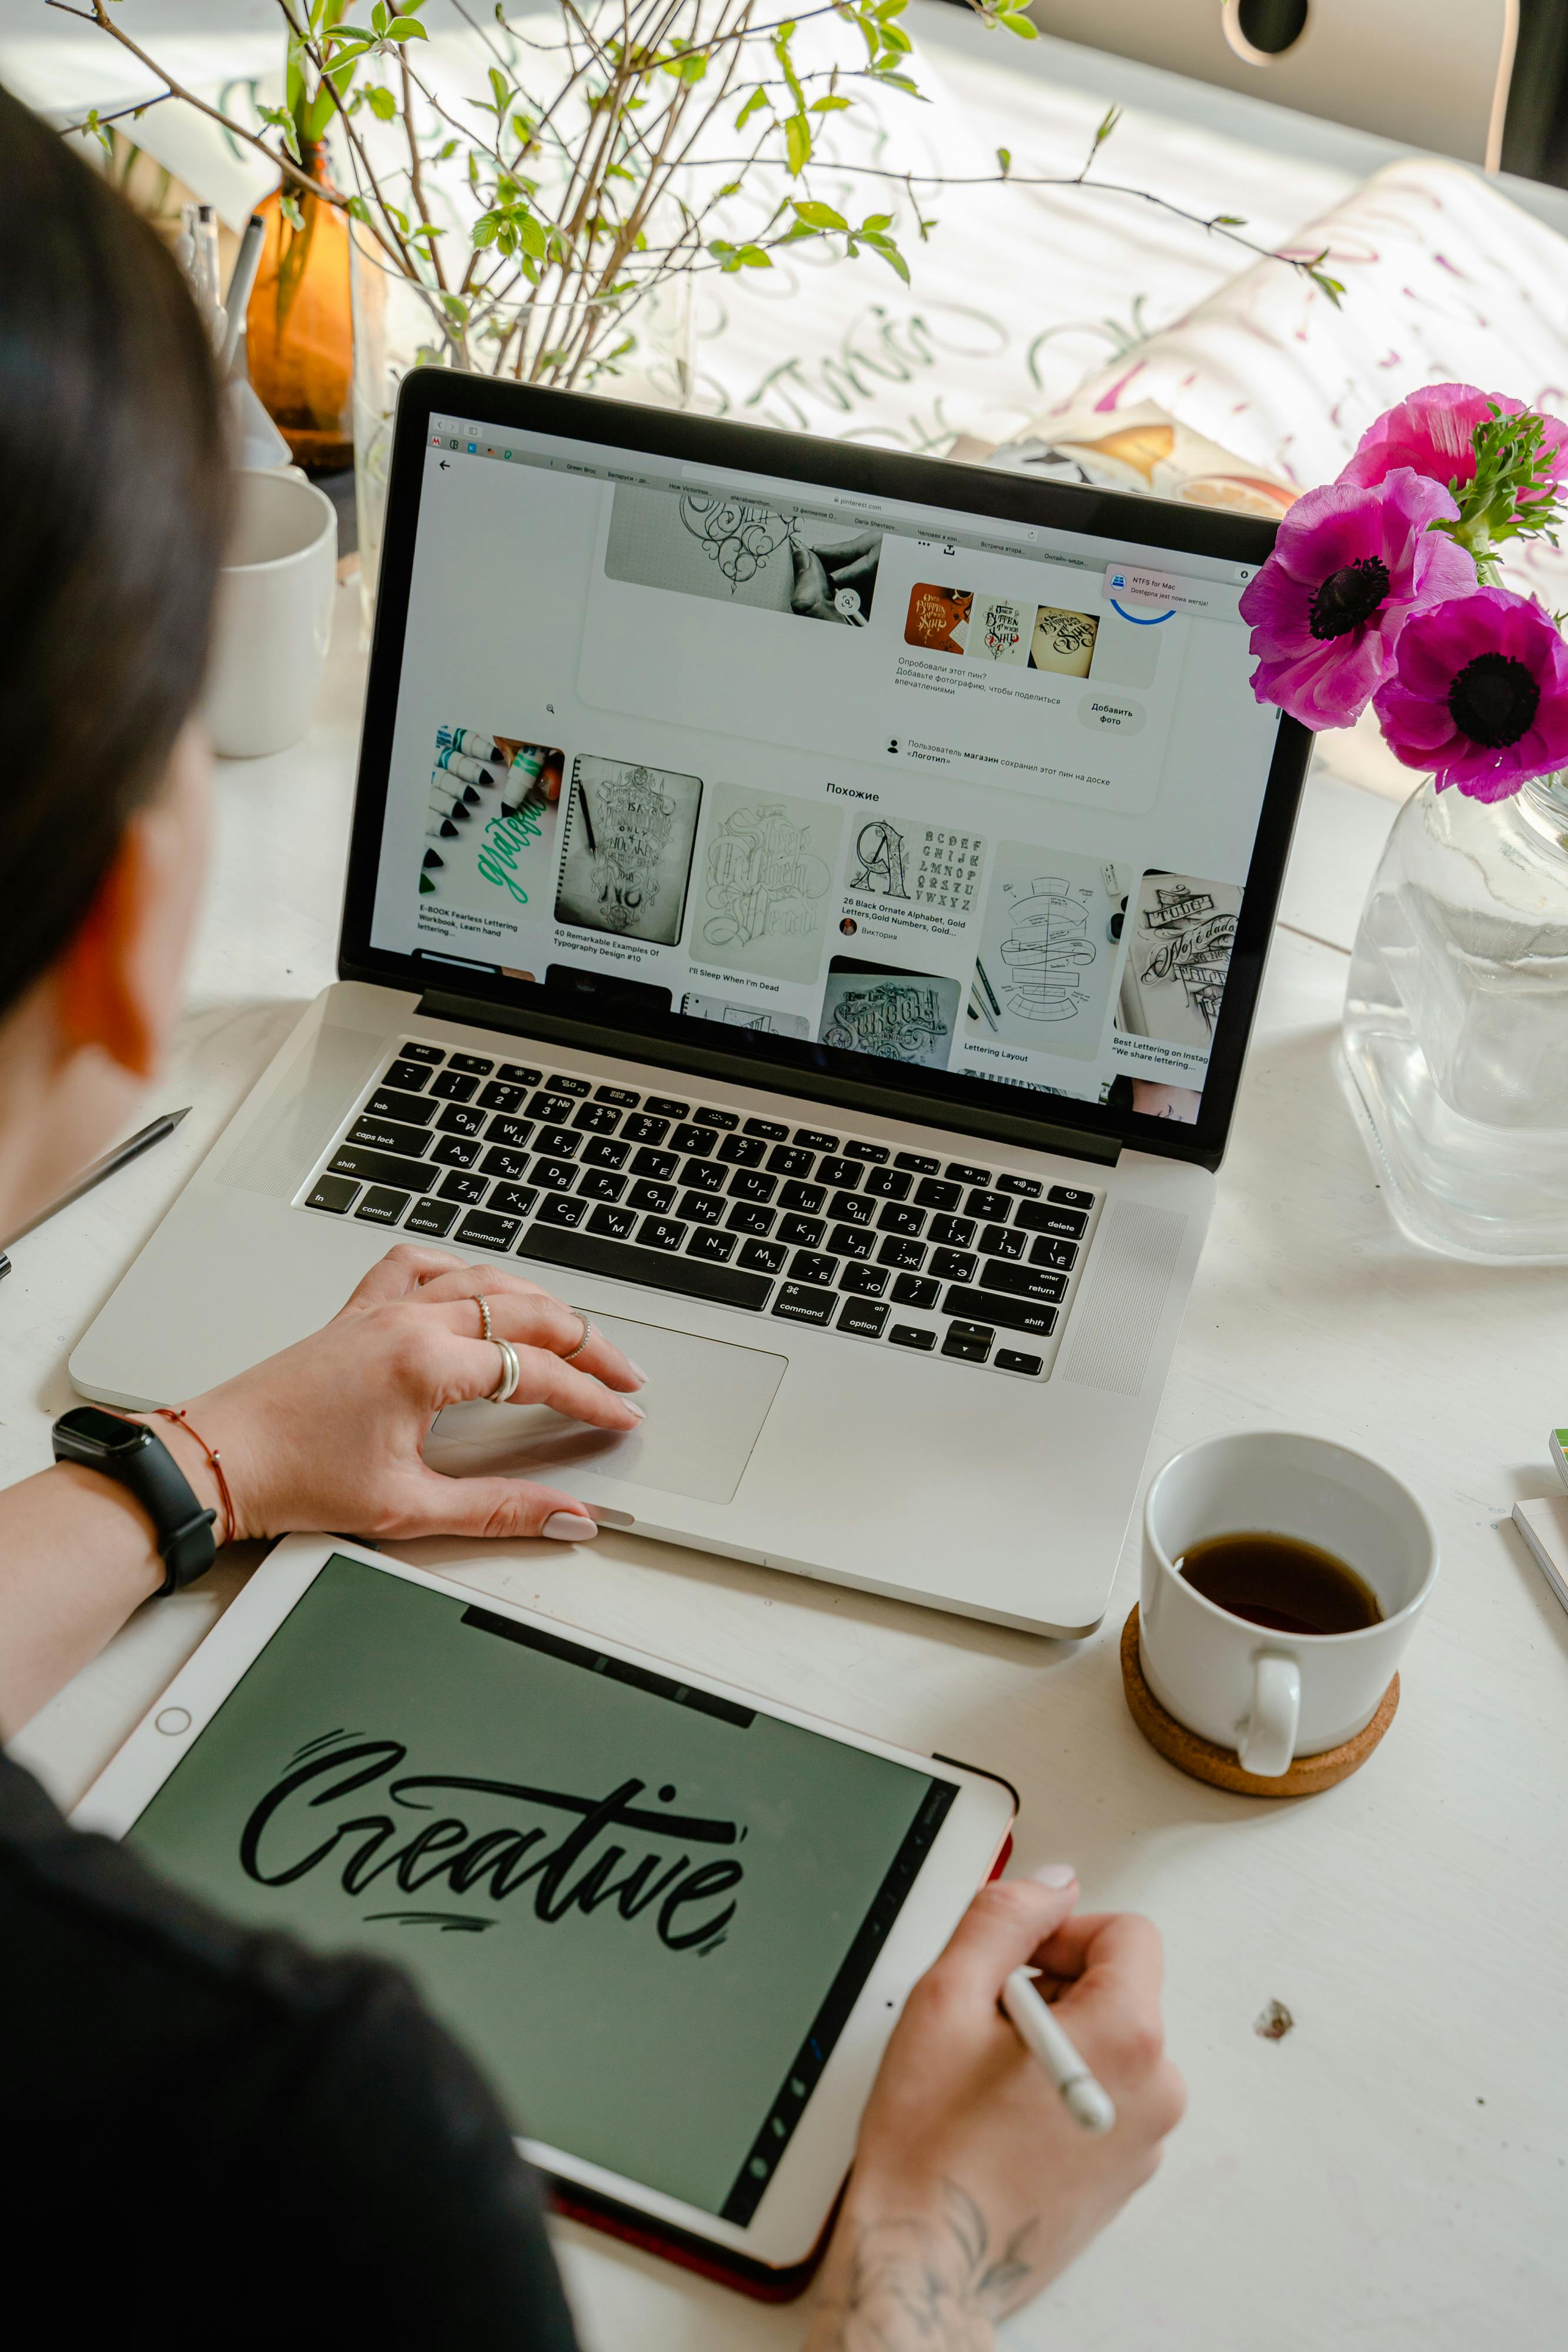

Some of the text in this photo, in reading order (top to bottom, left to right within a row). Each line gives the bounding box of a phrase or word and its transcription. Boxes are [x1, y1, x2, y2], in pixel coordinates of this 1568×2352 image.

[840, 498, 881, 511] pinterest.com
[917, 529, 941, 539] Человек
[980, 541, 1004, 551] Встреча
[1132, 577, 1150, 586] NTFS
[1162, 582, 1175, 590] Mac
[1131, 587, 1158, 597] Dostępna
[898, 657, 987, 680] Опробовали этот пин?
[895, 667, 1061, 704] Добавьте фотографию, чтобы поделиться
[895, 678, 955, 695] впечатлениями
[1091, 703, 1132, 717] Добавить
[1099, 715, 1121, 725] фото
[907, 751, 950, 763] «Логотип»
[908, 740, 962, 756] Пользователь
[964, 752, 999, 764] магазин
[1000, 759, 1038, 771] сохранил
[1039, 767, 1057, 775] этот
[1086, 776, 1110, 786] доске
[826, 782, 879, 801] Похожие
[843, 897, 965, 928] 26 Black Ornate Alphabet, Gold
[420, 904, 518, 933] E-BOOK Fearless Lettering
[419, 913, 502, 937] Workbook, Learn hand
[891, 917, 928, 932] Numbers,
[861, 927, 897, 940] Виктория
[566, 931, 610, 947] Remarkable
[612, 941, 648, 954] Examples
[553, 937, 641, 963] Typography Design #10
[700, 969, 721, 980] Sleep
[723, 974, 744, 984] When
[746, 979, 757, 987] I'm
[759, 982, 779, 992] Dead
[1113, 1037, 1132, 1047] Best
[1133, 1041, 1169, 1056] Lettering
[964, 1043, 1028, 1062] Lettering Layout
[1130, 1051, 1152, 1061] share
[456, 1114, 467, 1122] Q
[504, 1125, 517, 1134] W
[377, 1136, 394, 1144] lock
[554, 1136, 563, 1144] E
[450, 1147, 460, 1155] A
[601, 1147, 611, 1155] R
[458, 1181, 469, 1190] Z
[748, 1180, 758, 1188] U
[507, 1192, 519, 1201] X
[558, 1204, 568, 1212] C
[696, 1201, 707, 1210] H
[363, 1207, 392, 1217] control
[412, 1219, 437, 1228] option
[609, 1215, 618, 1224] V
[657, 1227, 666, 1235] B
[797, 1224, 807, 1233] K
[1048, 1221, 1074, 1231] delete
[463, 1230, 505, 1244] command
[848, 1235, 854, 1244] L
[707, 1238, 718, 1247] N
[755, 1250, 768, 1259] M
[1029, 1285, 1055, 1294] return
[780, 1304, 823, 1317] command
[850, 1321, 877, 1330] option
[240, 1741, 743, 1950] Creative
